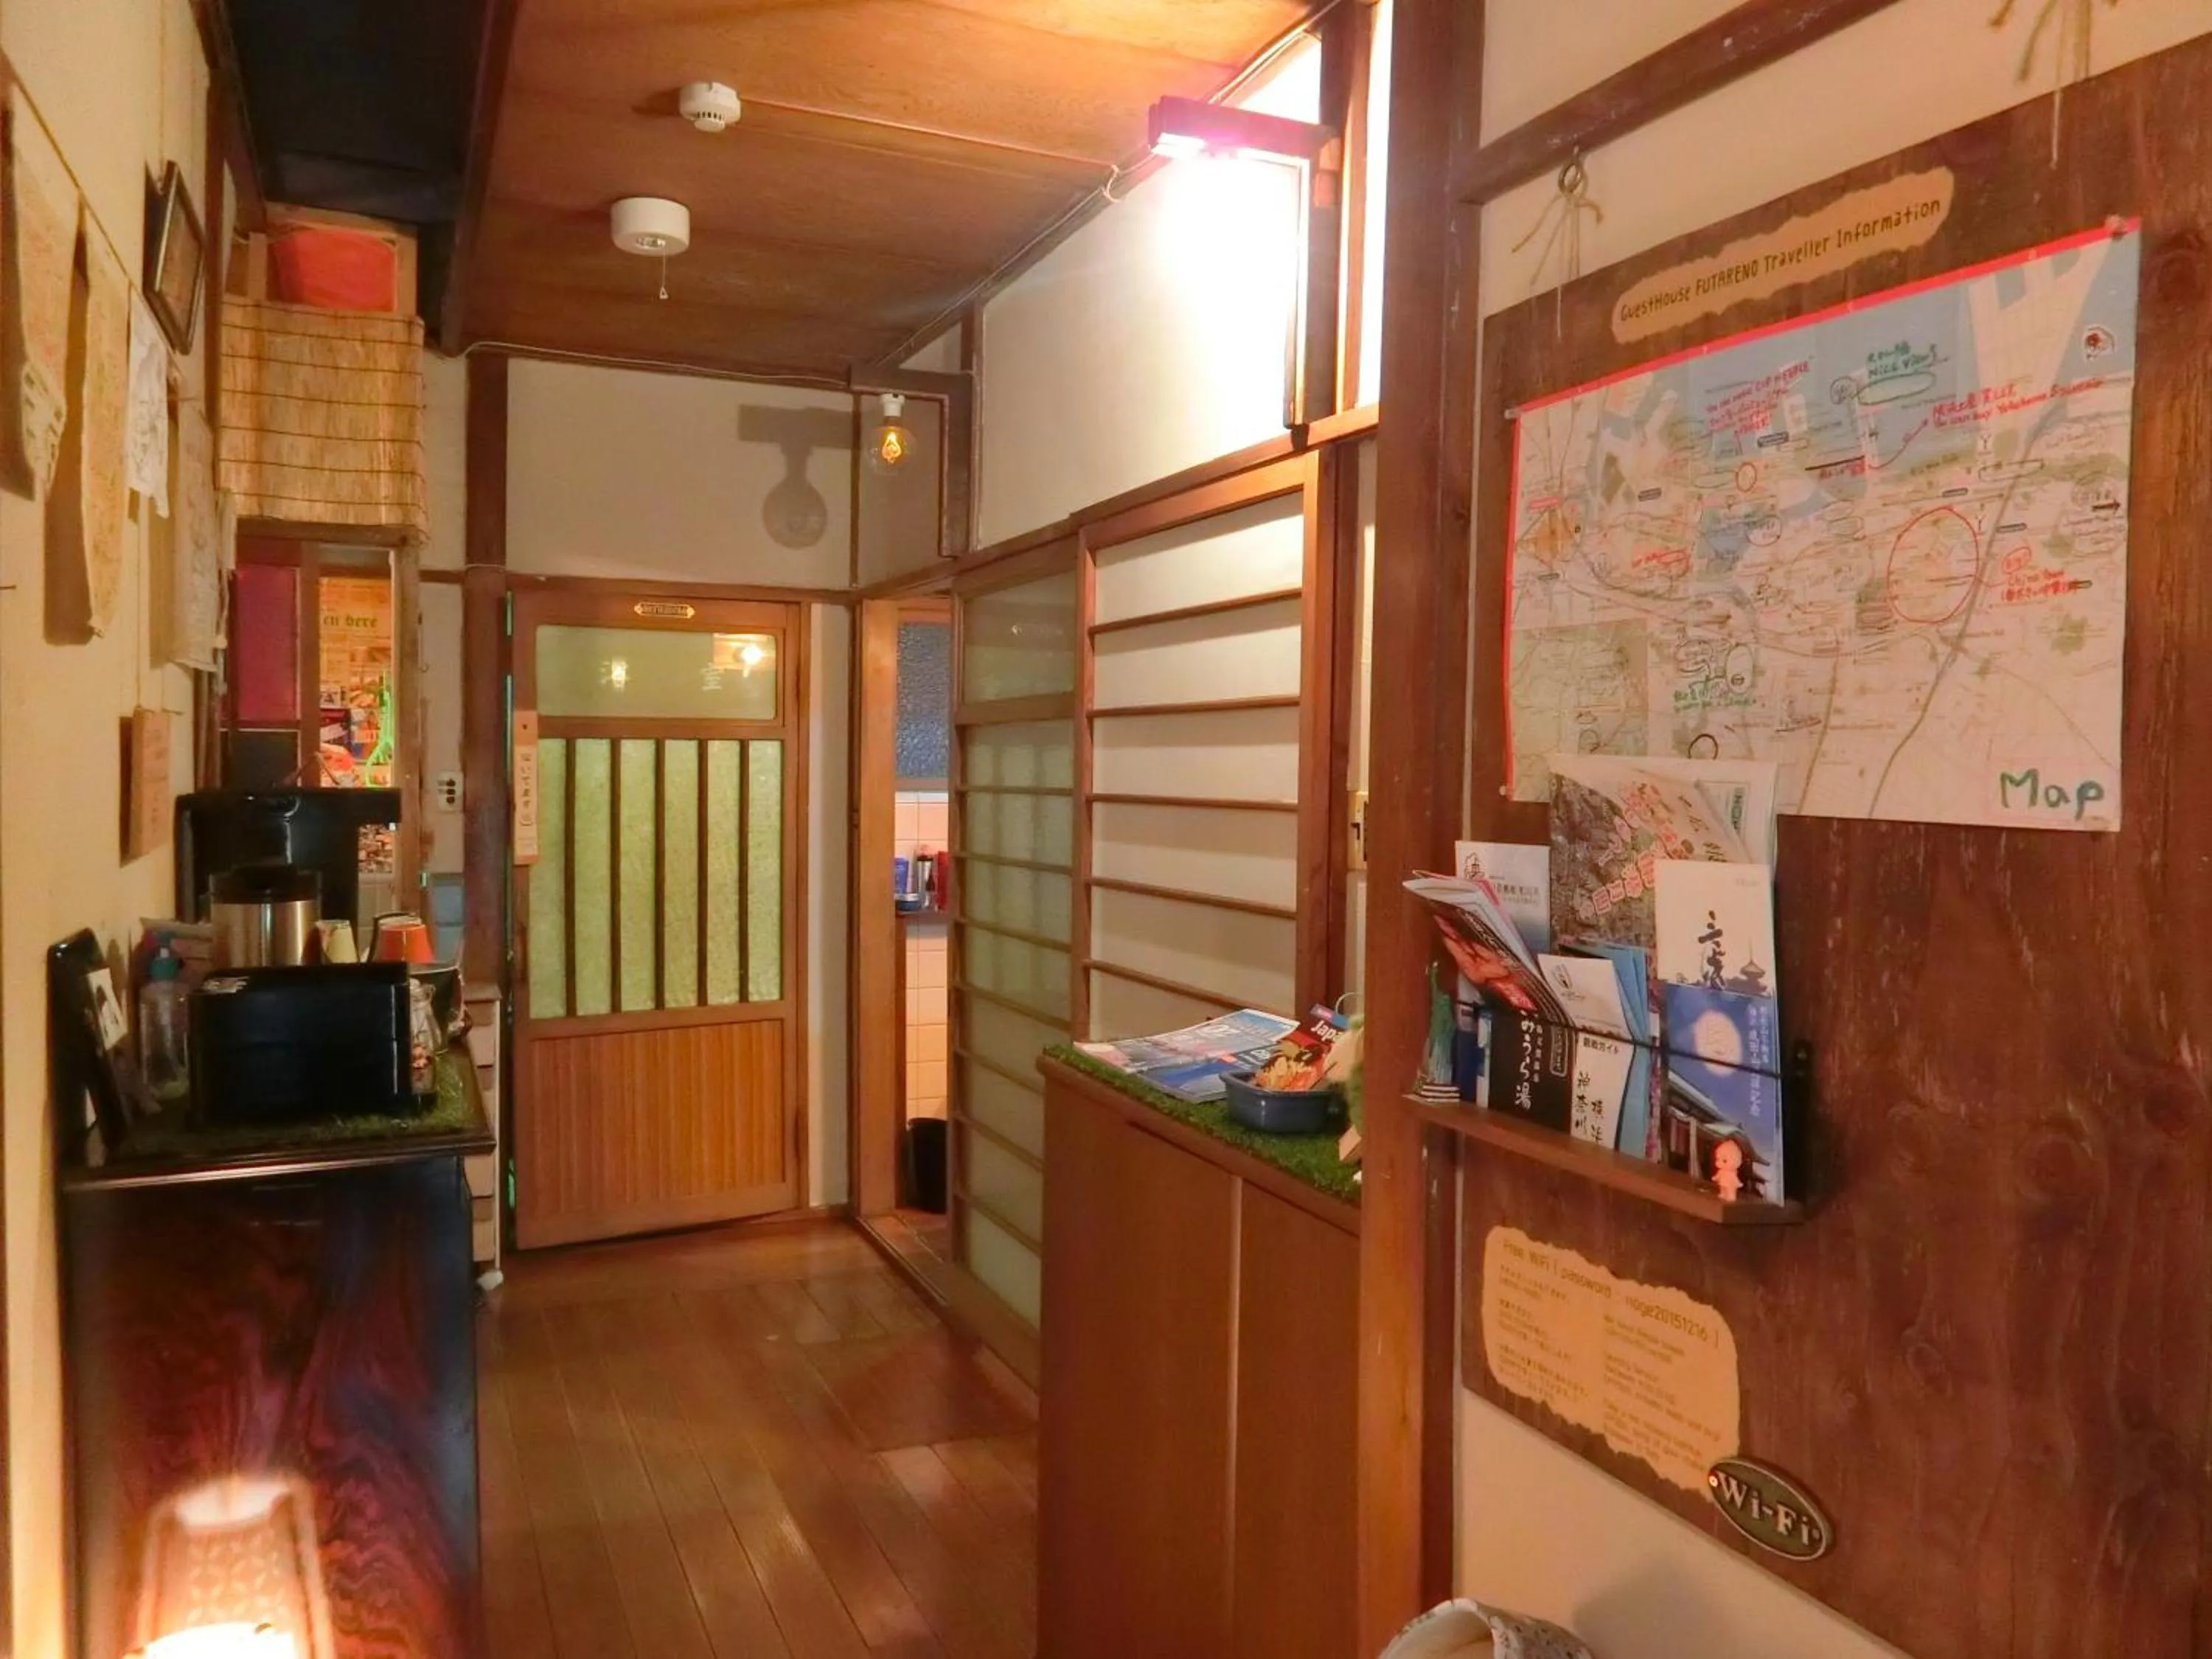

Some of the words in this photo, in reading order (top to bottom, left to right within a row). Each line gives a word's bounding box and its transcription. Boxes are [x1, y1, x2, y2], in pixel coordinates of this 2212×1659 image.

[1696, 260, 1759, 296] FUTARENO
[1764, 236, 1830, 273] Traveller
[1837, 198, 1941, 249] Information
[2000, 768, 2105, 821] Map
[1560, 1267, 1613, 1299] password
[1715, 1471, 1812, 1546] Wi-Fi
